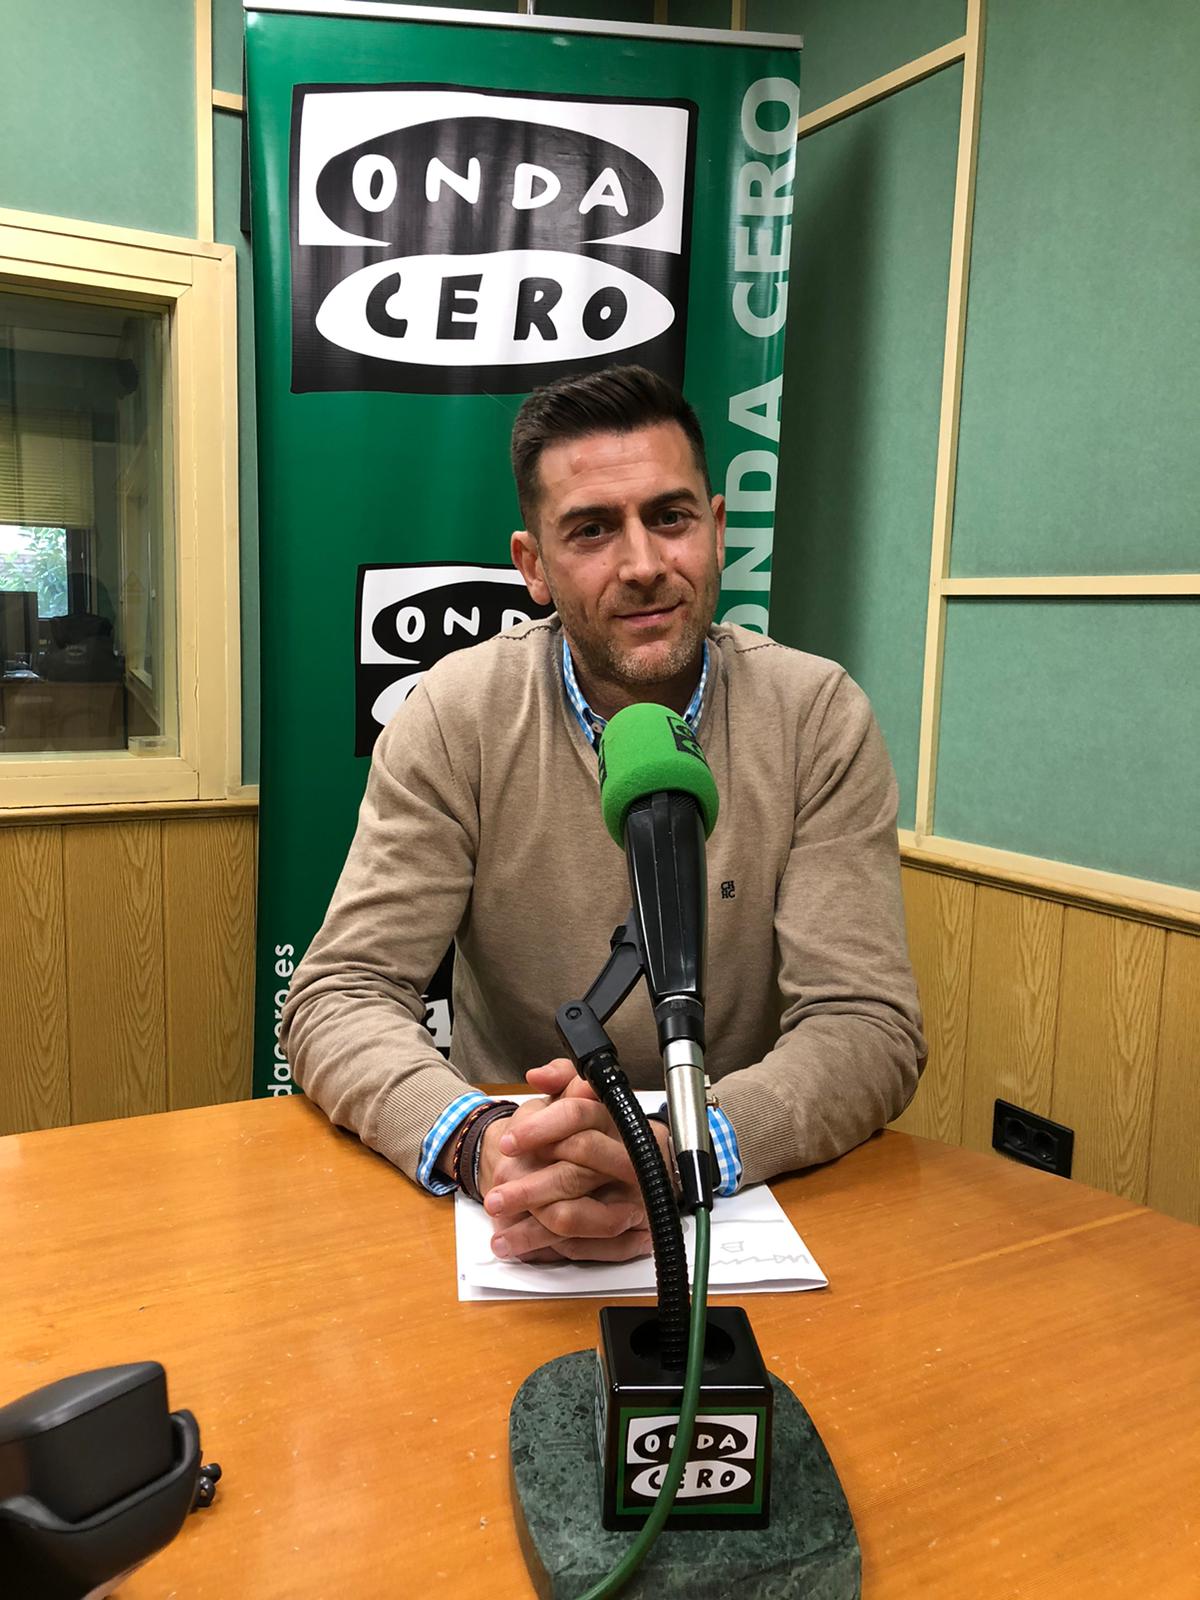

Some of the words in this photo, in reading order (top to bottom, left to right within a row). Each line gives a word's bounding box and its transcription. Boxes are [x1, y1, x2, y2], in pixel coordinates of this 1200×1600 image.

[352, 154, 629, 217] ONDA
[732, 76, 800, 338] CERO
[365, 272, 628, 342] CERO
